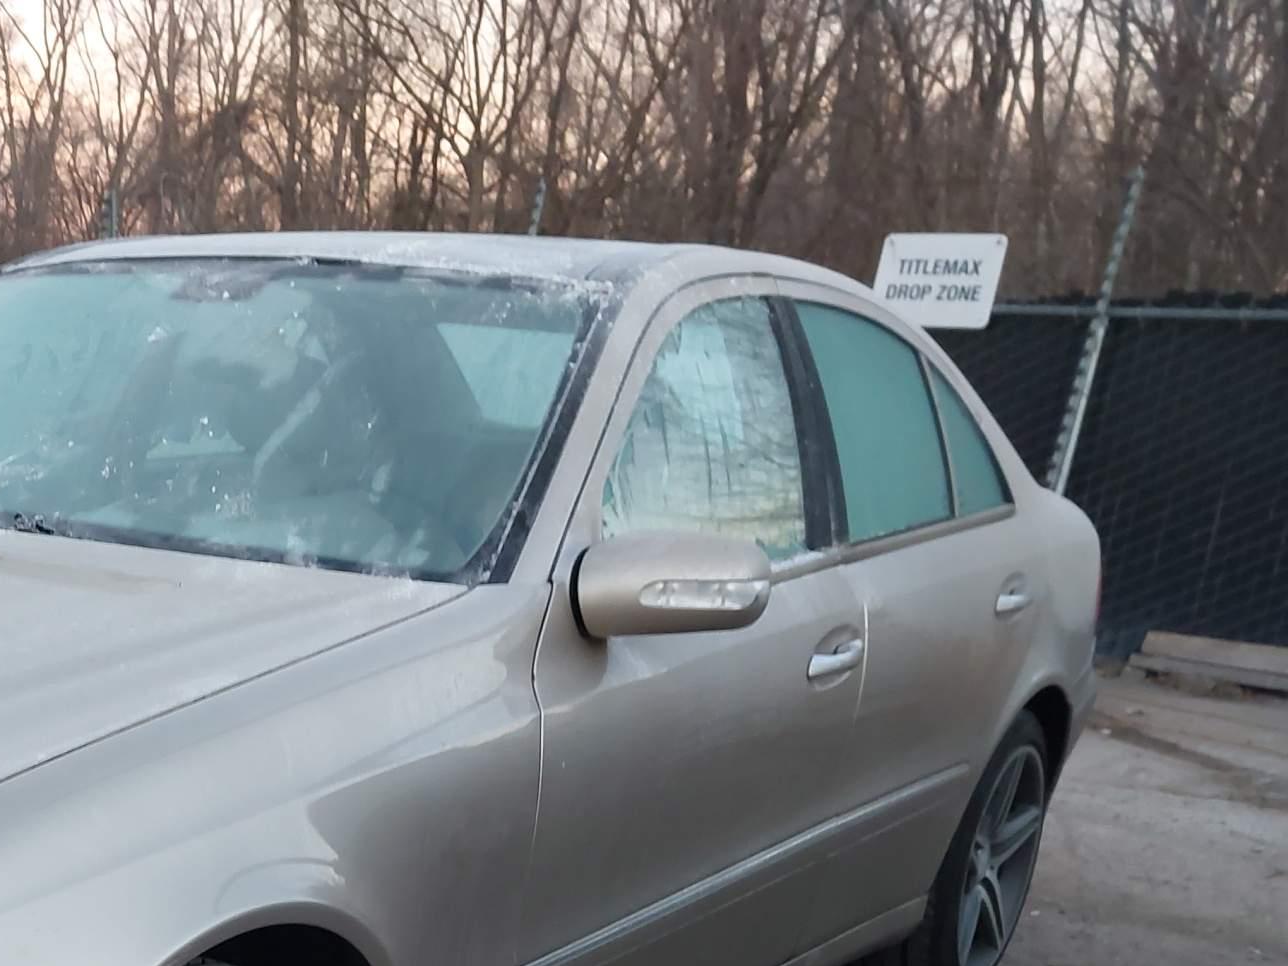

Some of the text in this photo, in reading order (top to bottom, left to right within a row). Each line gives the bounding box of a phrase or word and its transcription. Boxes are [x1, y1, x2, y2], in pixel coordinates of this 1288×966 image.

[899, 259, 983, 275] TITLEMAX
[885, 284, 982, 301] DROP ZONE
